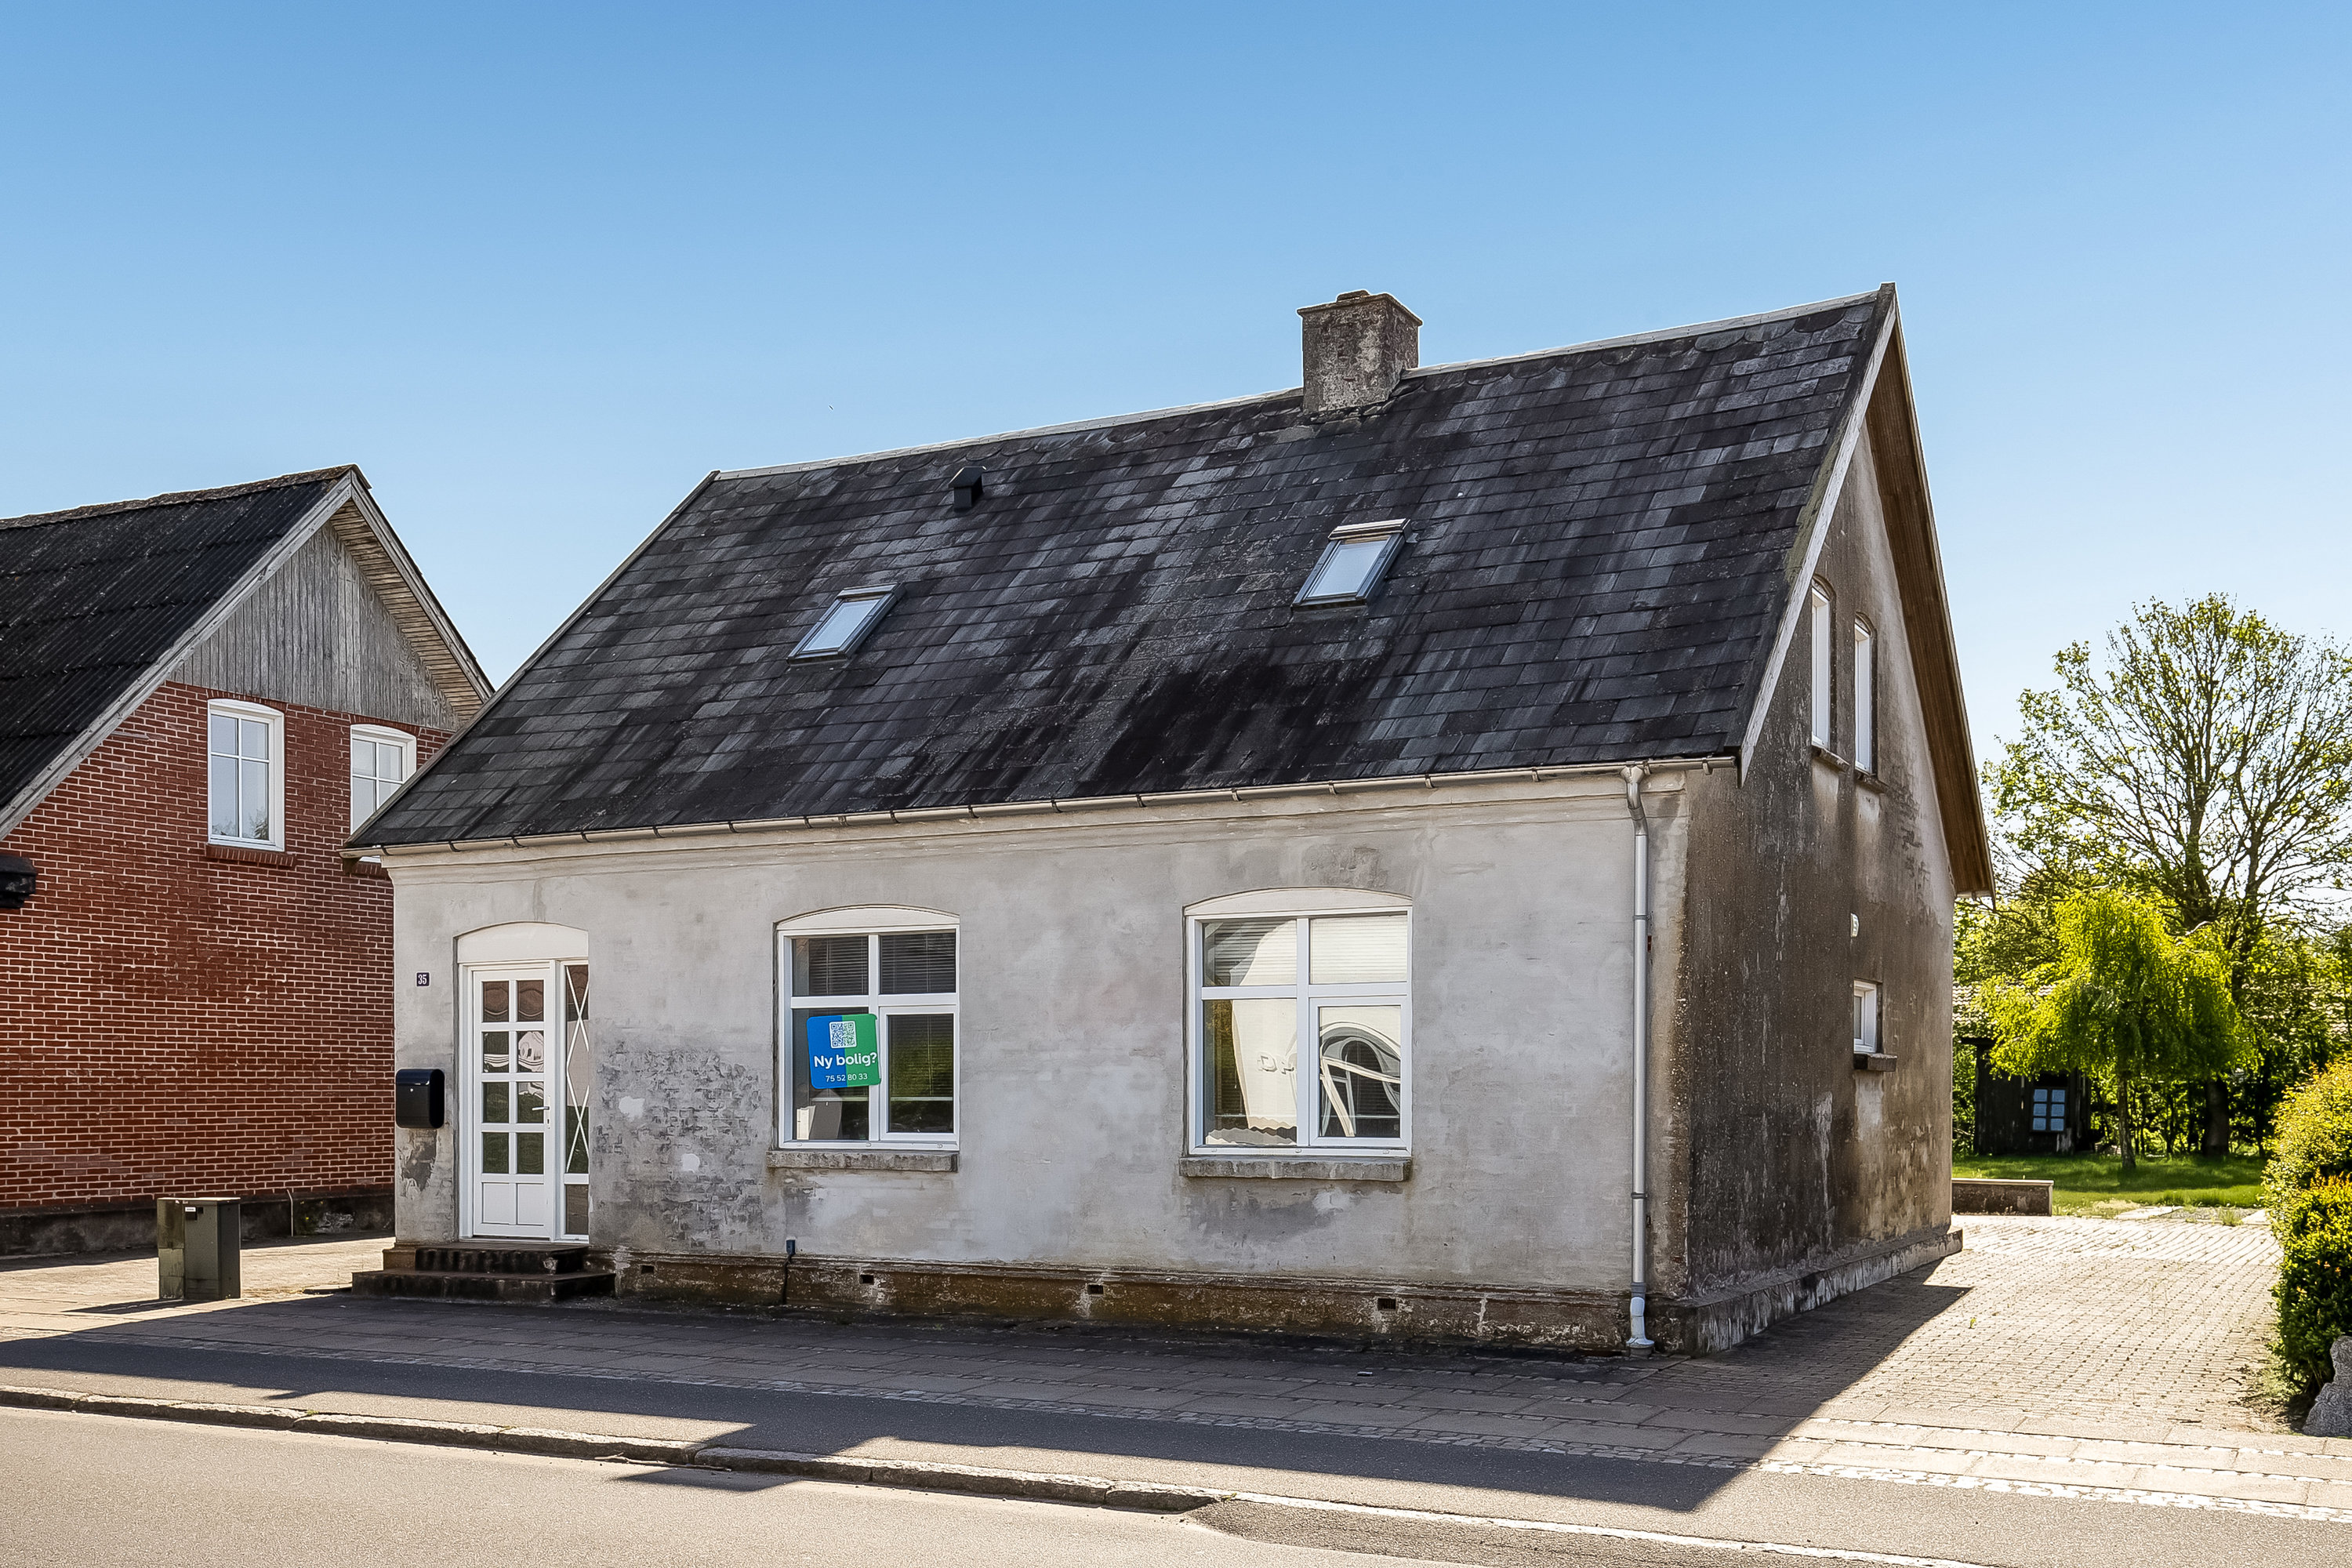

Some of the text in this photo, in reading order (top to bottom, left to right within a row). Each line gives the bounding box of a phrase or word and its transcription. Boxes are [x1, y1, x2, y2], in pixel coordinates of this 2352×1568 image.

[418, 974, 427, 985] 35
[814, 1052, 877, 1069] Ny bolig?
